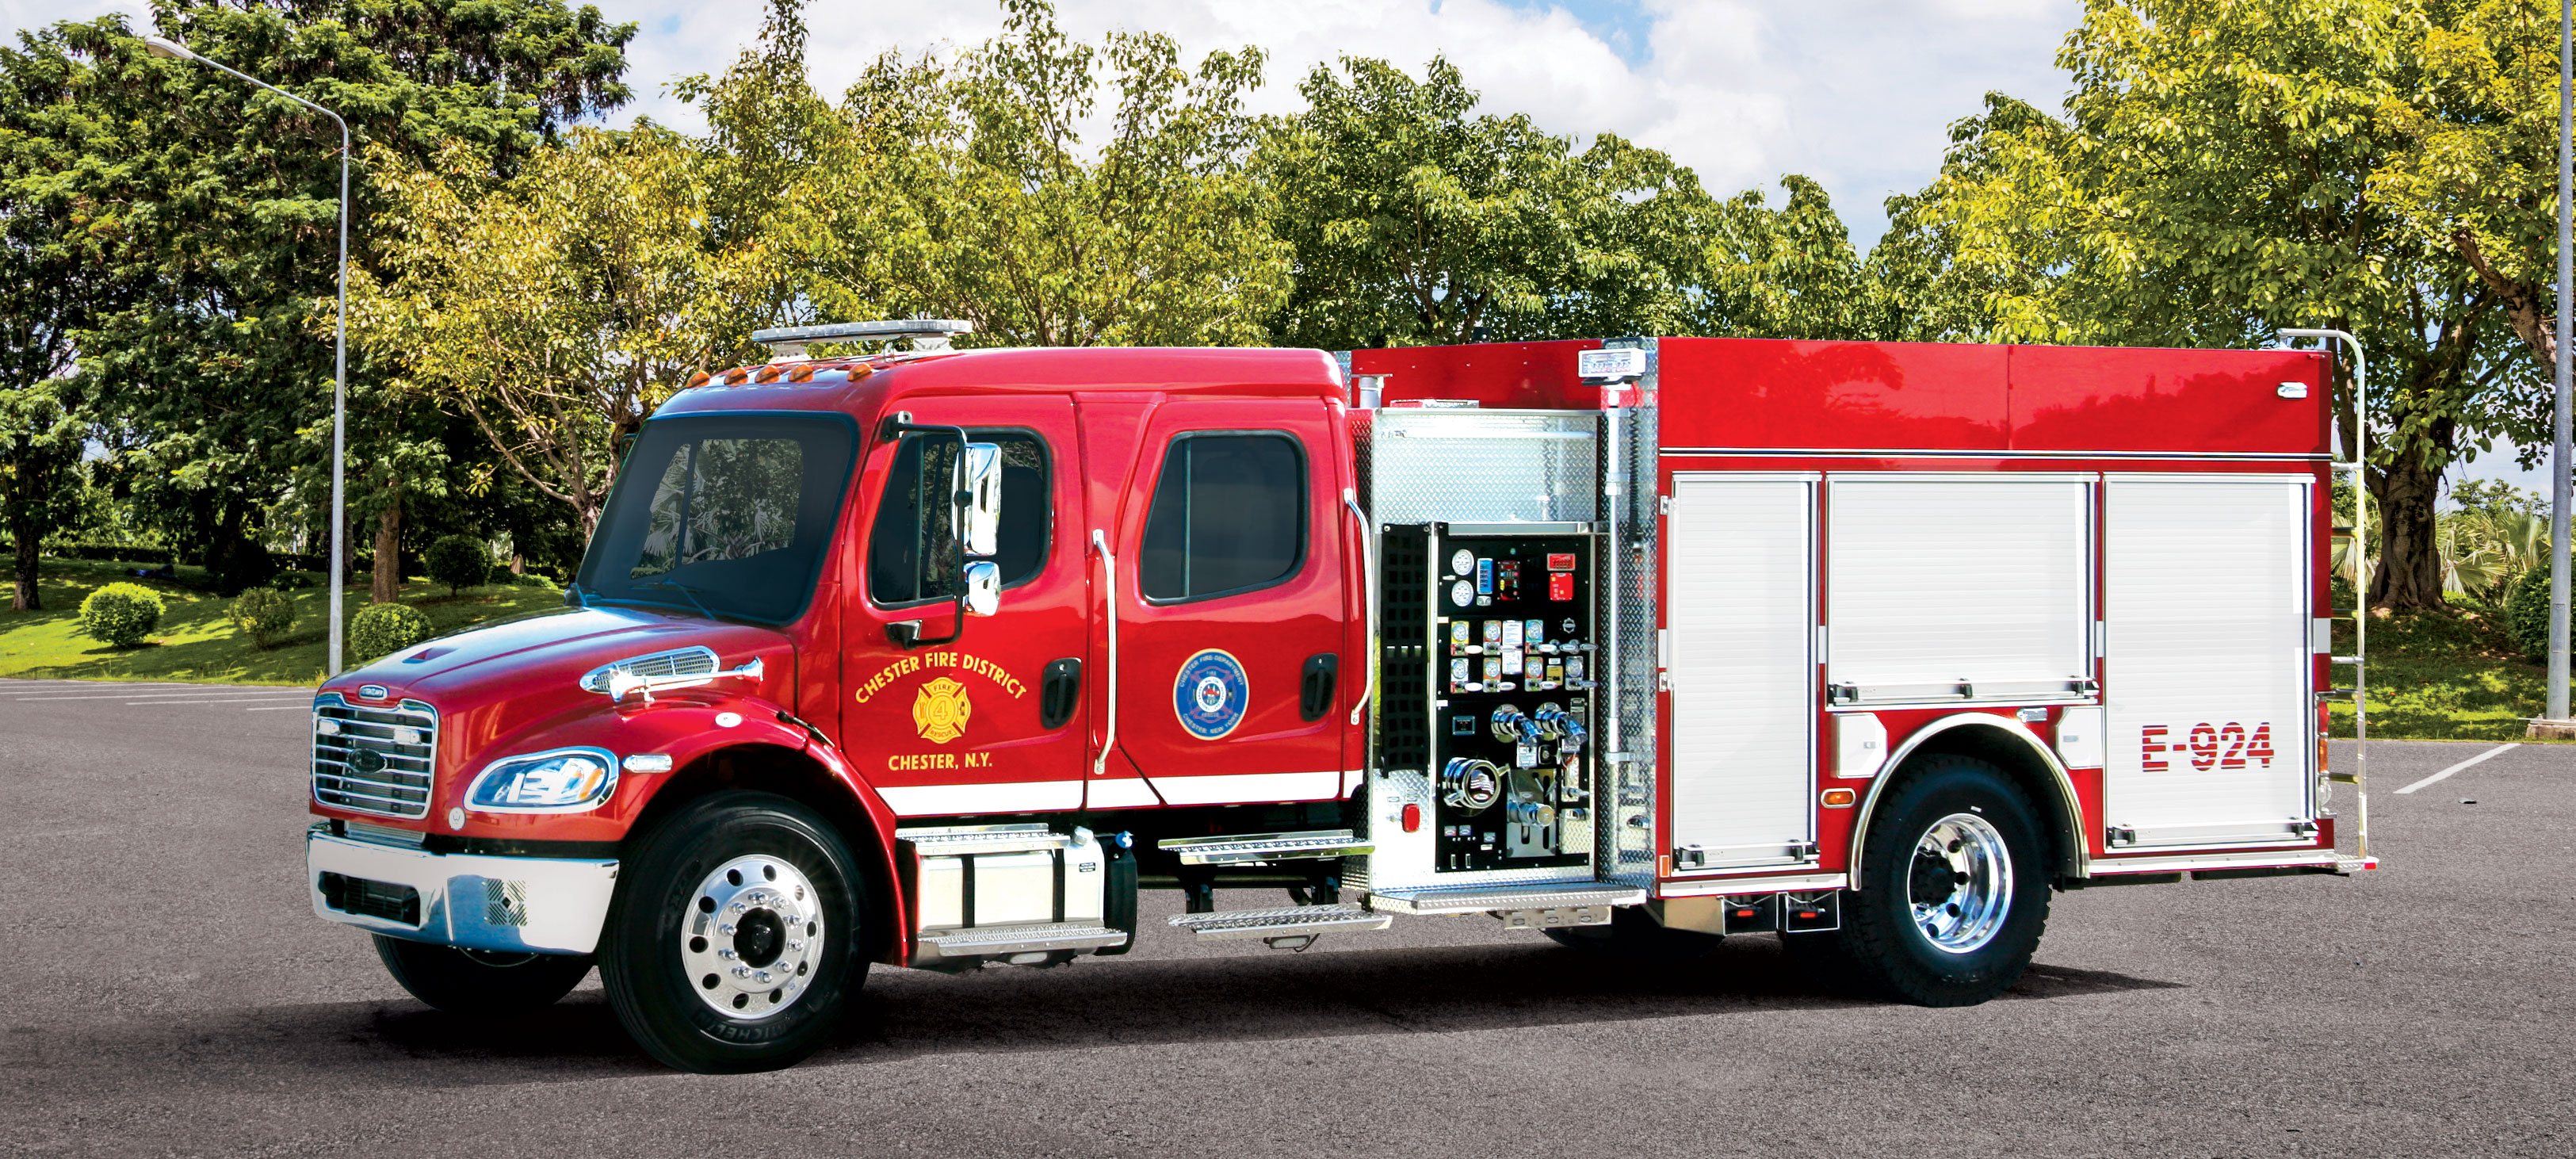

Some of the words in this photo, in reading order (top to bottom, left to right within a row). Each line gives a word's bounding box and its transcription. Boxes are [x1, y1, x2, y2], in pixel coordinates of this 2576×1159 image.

[855, 656, 919, 703] CHESTER
[925, 652, 958, 667] FIRE
[963, 654, 1026, 699] DISTRICT
[933, 700, 948, 721] 4
[889, 755, 958, 771] CHESTER,
[965, 752, 992, 768] N.Y.
[2142, 721, 2275, 772] E-924
